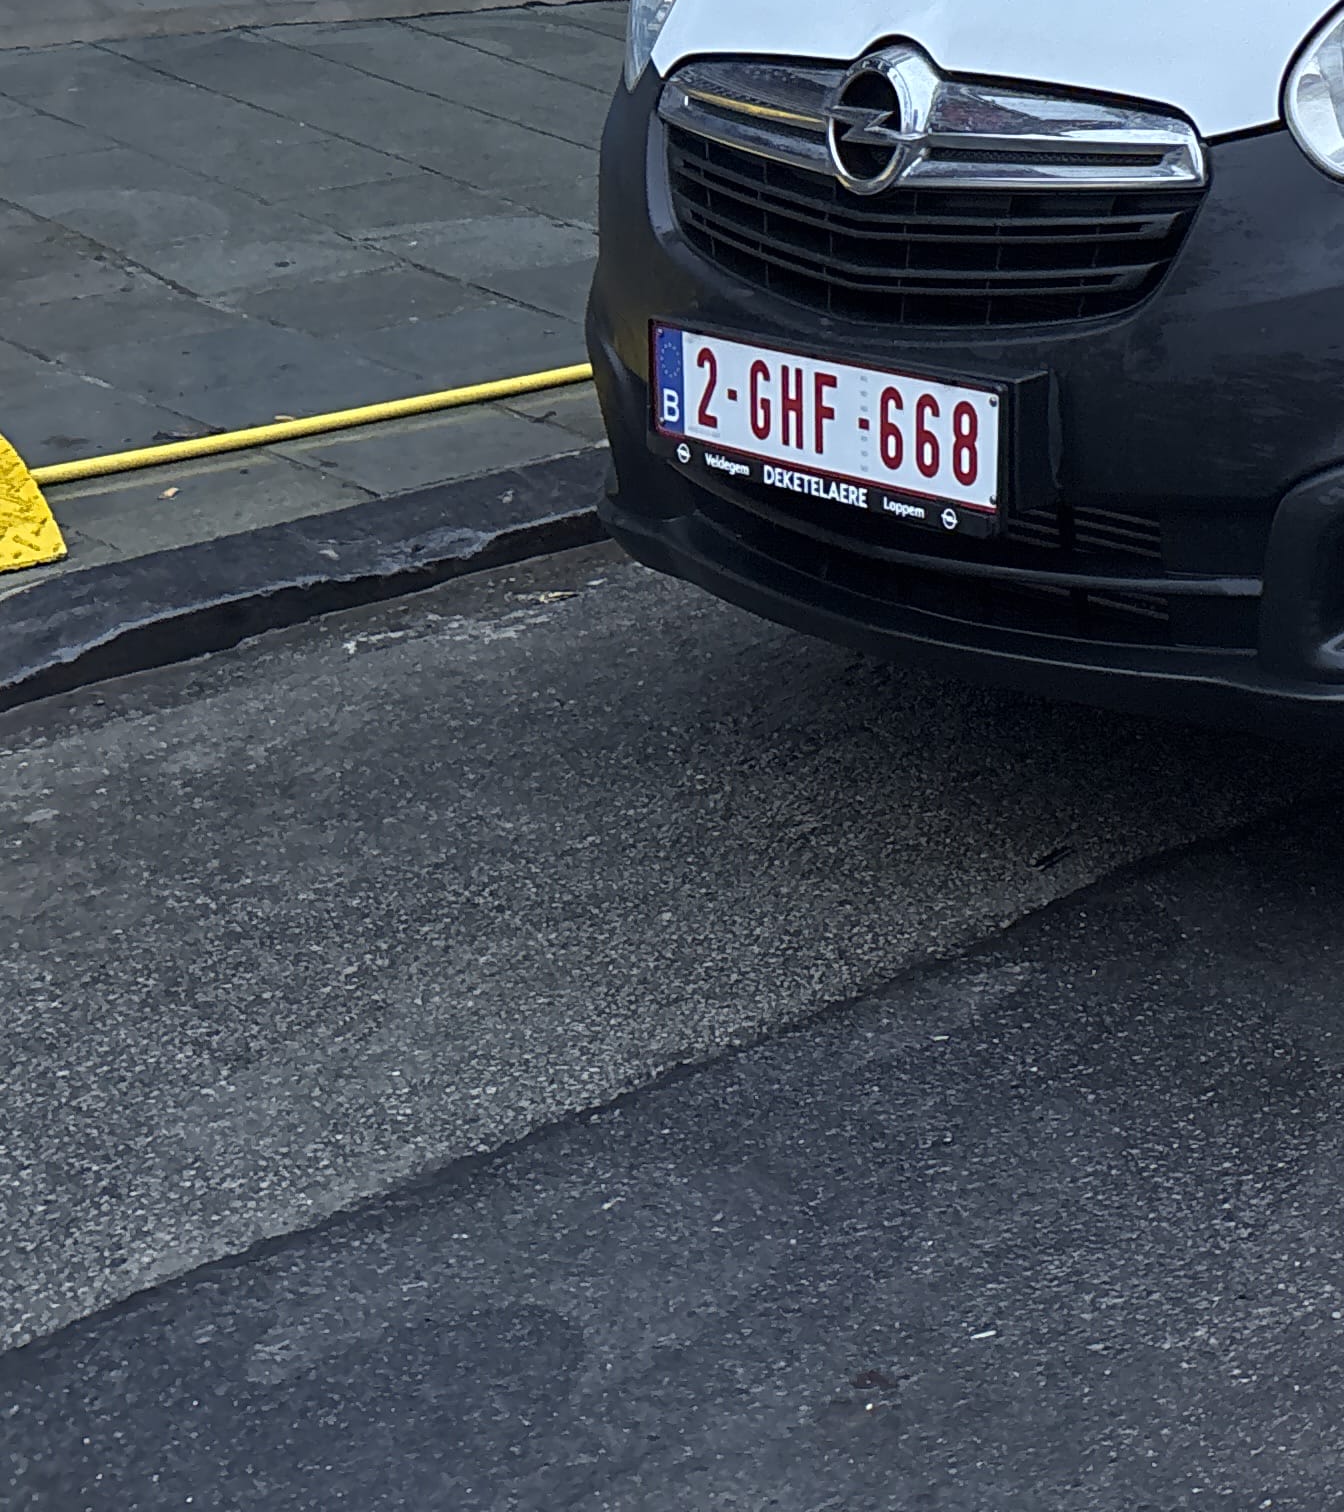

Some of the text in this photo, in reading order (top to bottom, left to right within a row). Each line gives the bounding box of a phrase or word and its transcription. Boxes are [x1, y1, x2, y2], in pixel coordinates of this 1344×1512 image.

[663, 347, 979, 486] B 2-GHF-668
[705, 452, 925, 519] Veldegem DEKETELAERE Loppem
